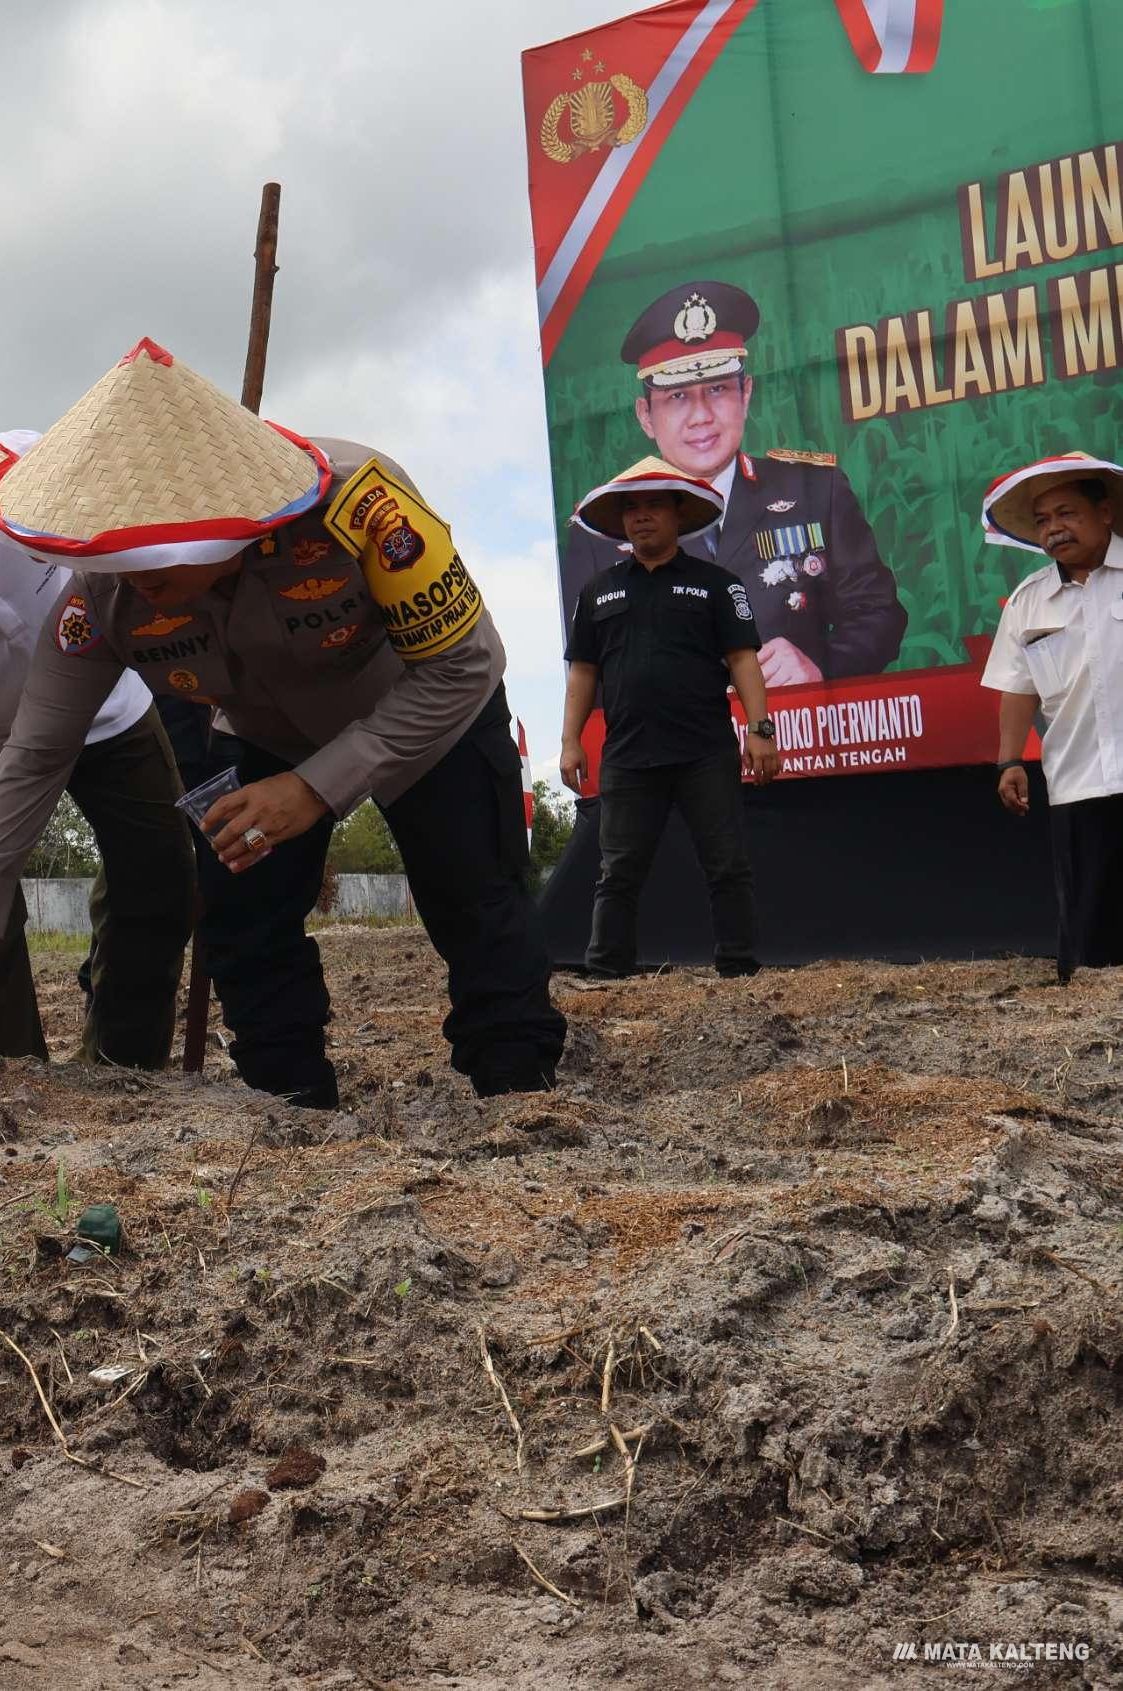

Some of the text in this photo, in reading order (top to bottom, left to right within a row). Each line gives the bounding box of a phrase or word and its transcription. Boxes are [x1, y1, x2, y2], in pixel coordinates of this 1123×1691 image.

[845, 286, 1044, 420] DALAM
[353, 489, 384, 526] POLDA
[596, 590, 626, 605] GUGUN
[133, 634, 210, 664] BENNY
[816, 695, 923, 747] POERWANTO
[840, 747, 906, 767] TENGAH
